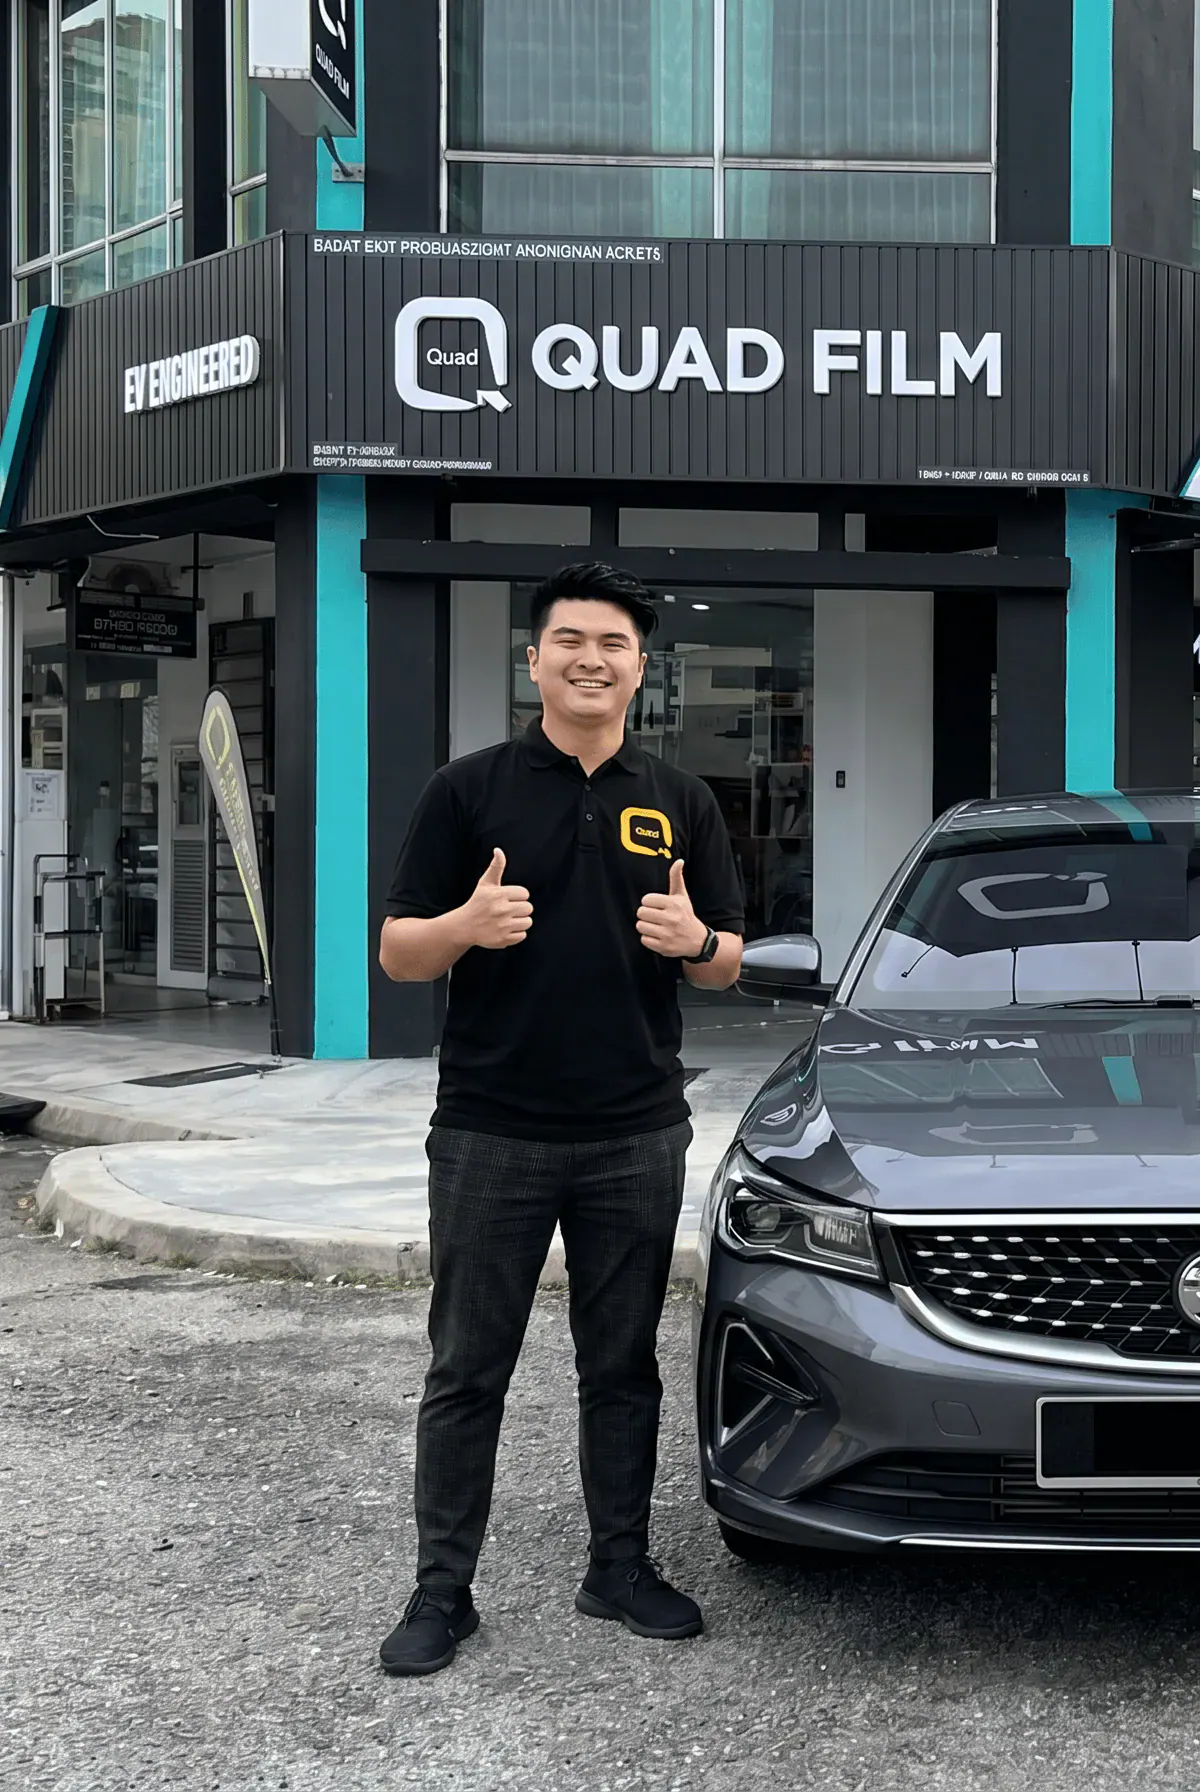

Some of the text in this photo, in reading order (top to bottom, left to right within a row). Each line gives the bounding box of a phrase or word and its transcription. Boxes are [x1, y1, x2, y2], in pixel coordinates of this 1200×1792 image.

[313, 238, 361, 253] BADAT
[515, 244, 602, 259] ANONIGNAN
[605, 246, 661, 261] ACRETS
[124, 334, 260, 414] EV ENGINEERED
[426, 348, 478, 366] Quad
[532, 323, 1002, 397] QUAD FILM
